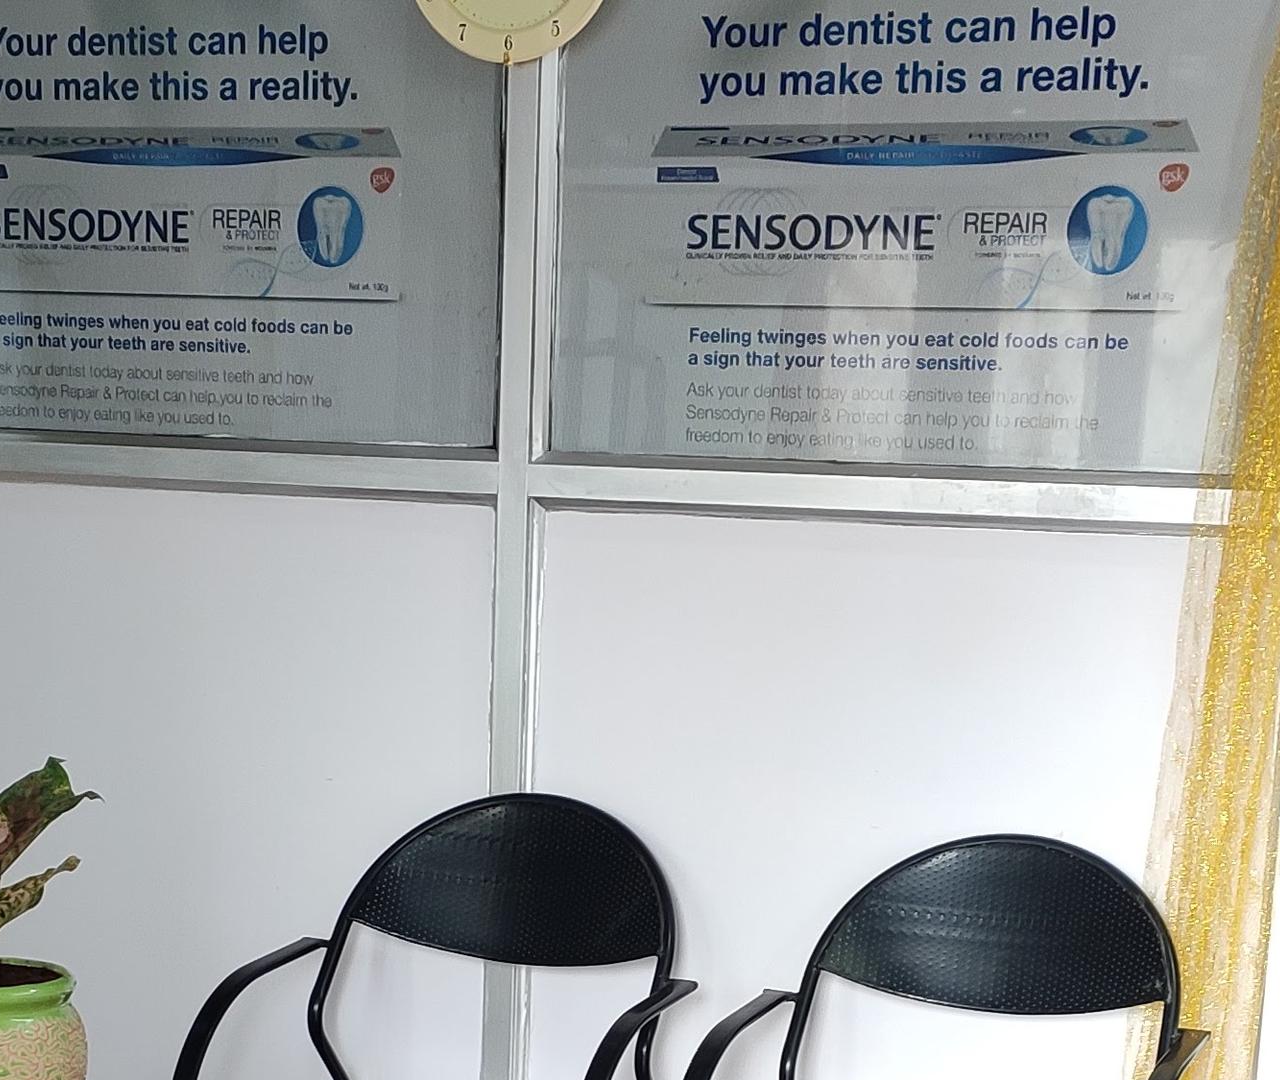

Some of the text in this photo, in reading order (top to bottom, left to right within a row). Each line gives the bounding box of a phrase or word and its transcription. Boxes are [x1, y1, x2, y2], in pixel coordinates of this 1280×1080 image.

[458, 24, 467, 41] 7
[551, 20, 560, 37] 5
[702, 5, 1116, 48] Your dentist can help
[67, 26, 177, 56] dentist
[188, 30, 246, 55] can
[258, 24, 328, 61] help
[504, 35, 513, 50] 6
[54, 71, 139, 101] make
[149, 71, 208, 101] this
[220, 76, 237, 101] a
[249, 70, 358, 107] reality.
[700, 56, 1149, 105] you make this a reality.
[372, 173, 390, 187] gsk
[1162, 167, 1185, 185] gsk
[213, 208, 281, 230] REPAIR
[963, 212, 1048, 234] REPAIR
[235, 230, 279, 241] PROTECT
[686, 214, 936, 251] SENSODYNE
[979, 234, 1046, 246] & PROTECT
[47, 313, 104, 330] twinges
[109, 315, 149, 330] when
[153, 318, 180, 333] you
[186, 318, 209, 331] eat
[214, 317, 246, 332] cold
[251, 318, 295, 333] foods
[300, 322, 328, 334] can
[334, 320, 353, 335] be
[3, 332, 33, 349] sign
[38, 333, 66, 348] that
[70, 336, 104, 351] your
[108, 335, 146, 350] teeth
[151, 339, 174, 351] are
[179, 338, 250, 353] sensitive.
[689, 327, 1129, 350] Feeling twinges when you eat cold foods can be
[687, 350, 1002, 371] a sign that your teeth are sensitive.
[16, 364, 42, 378] your
[46, 363, 86, 377] dentist
[90, 365, 123, 381] today
[127, 367, 162, 380] about
[166, 368, 219, 382] sensitive
[223, 370, 254, 383] teeth
[259, 371, 282, 384] and
[286, 371, 314, 385] how
[61, 384, 99, 401] Repair
[103, 386, 111, 400] &
[115, 386, 159, 402] Protect
[163, 390, 186, 402] can
[189, 390, 216, 406] help
[219, 393, 242, 407] you
[246, 393, 258, 405] to
[263, 392, 307, 406] reclaim
[312, 394, 332, 408] the
[686, 382, 1075, 405] Ask your dentist today about sensitive teeth and how
[44, 404, 55, 418] to
[58, 408, 90, 422] enjoy
[94, 408, 130, 423] eating
[134, 407, 154, 422] like
[158, 411, 180, 426] you
[184, 410, 214, 425] used
[686, 404, 765, 423] Sensodyne
[771, 406, 816, 424] Repair
[822, 407, 831, 423] &
[836, 408, 888, 424] Protect
[894, 411, 921, 425] can
[926, 411, 958, 429] help
[962, 414, 990, 430] you
[995, 413, 1009, 427] to
[1014, 413, 1068, 429] reclaim
[686, 427, 743, 443] freedom
[748, 429, 762, 444] to
[767, 431, 805, 447] enjoy
[809, 431, 853, 448] eating
[886, 434, 912, 449] you
[918, 435, 955, 450] used
